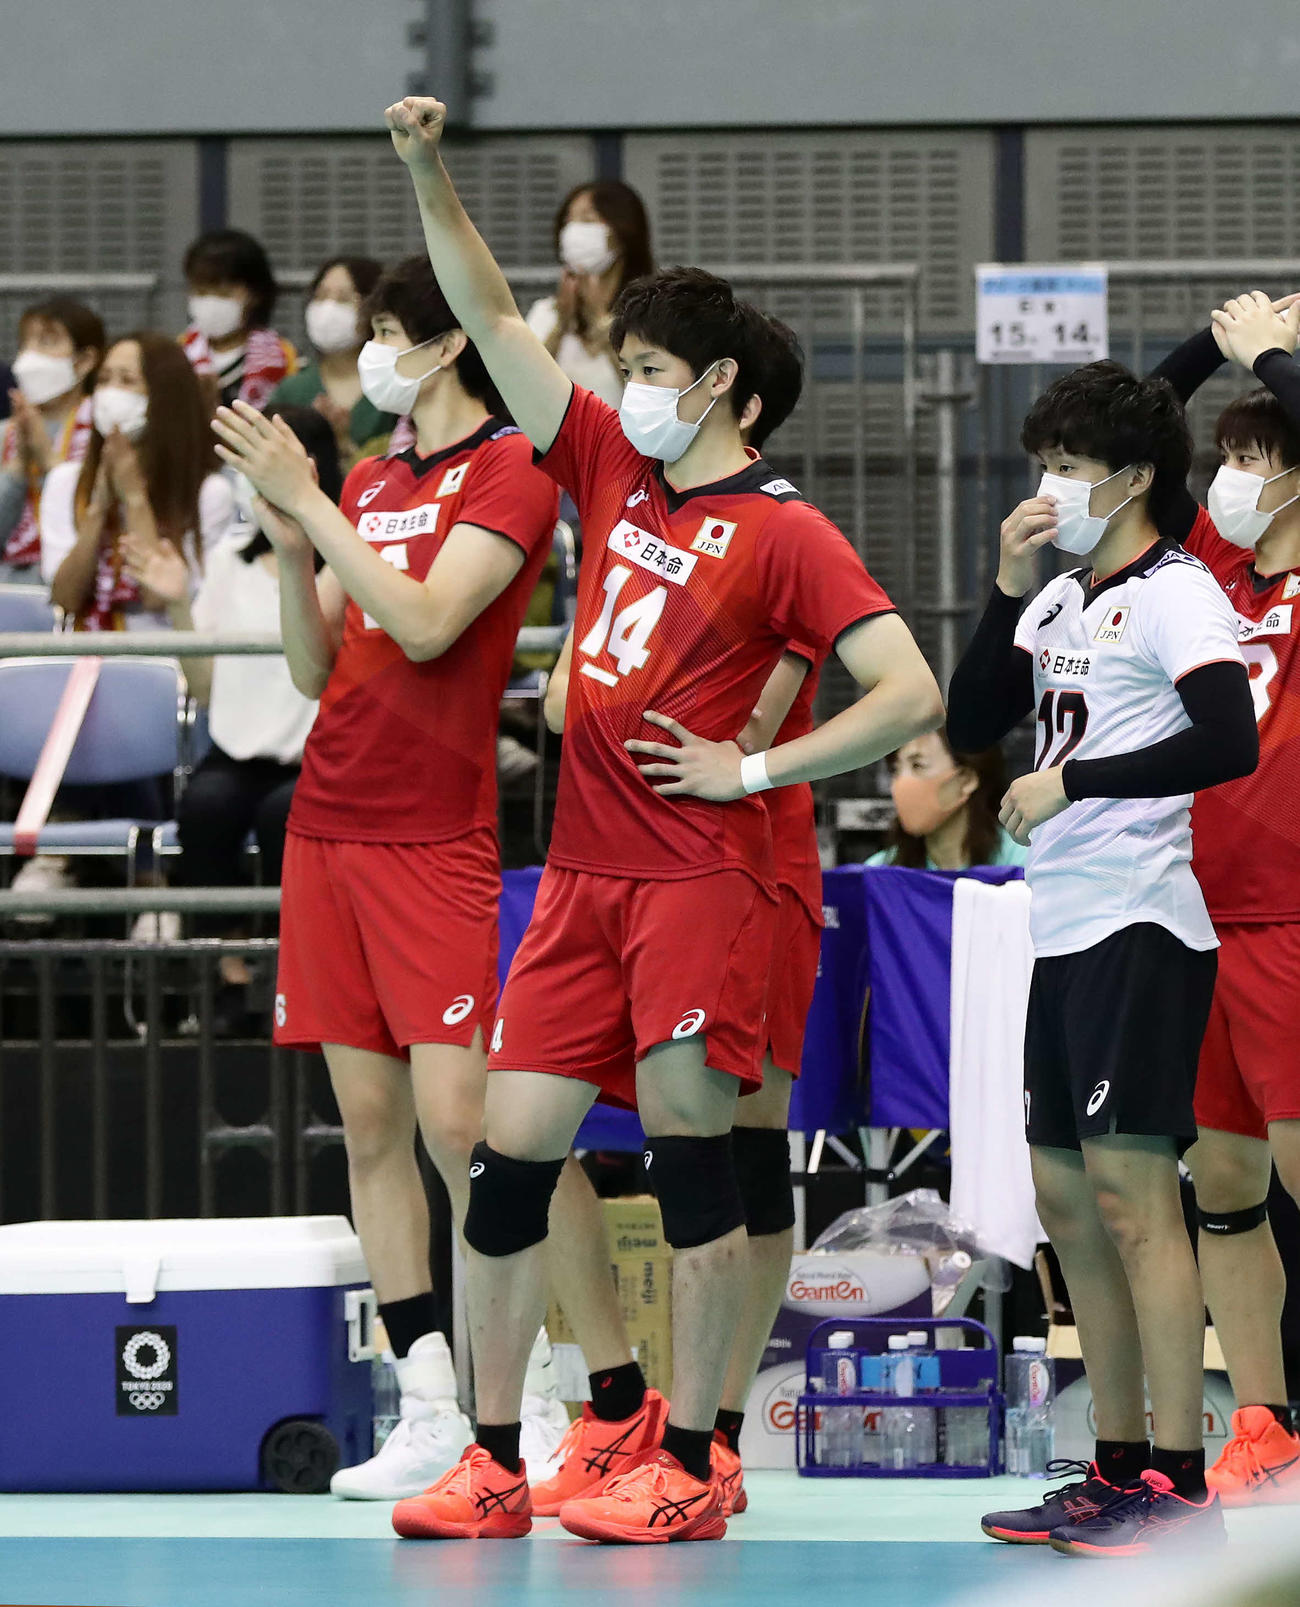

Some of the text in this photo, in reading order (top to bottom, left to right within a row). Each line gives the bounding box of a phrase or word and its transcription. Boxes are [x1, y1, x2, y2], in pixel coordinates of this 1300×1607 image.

[385, 511, 428, 534] 日本生命
[697, 541, 724, 554] JPN
[578, 563, 668, 678] 14
[1099, 630, 1121, 640] JPN
[1052, 655, 1091, 676] 日本生命
[617, 1236, 658, 1251] meiji
[642, 1262, 656, 1304] meiji
